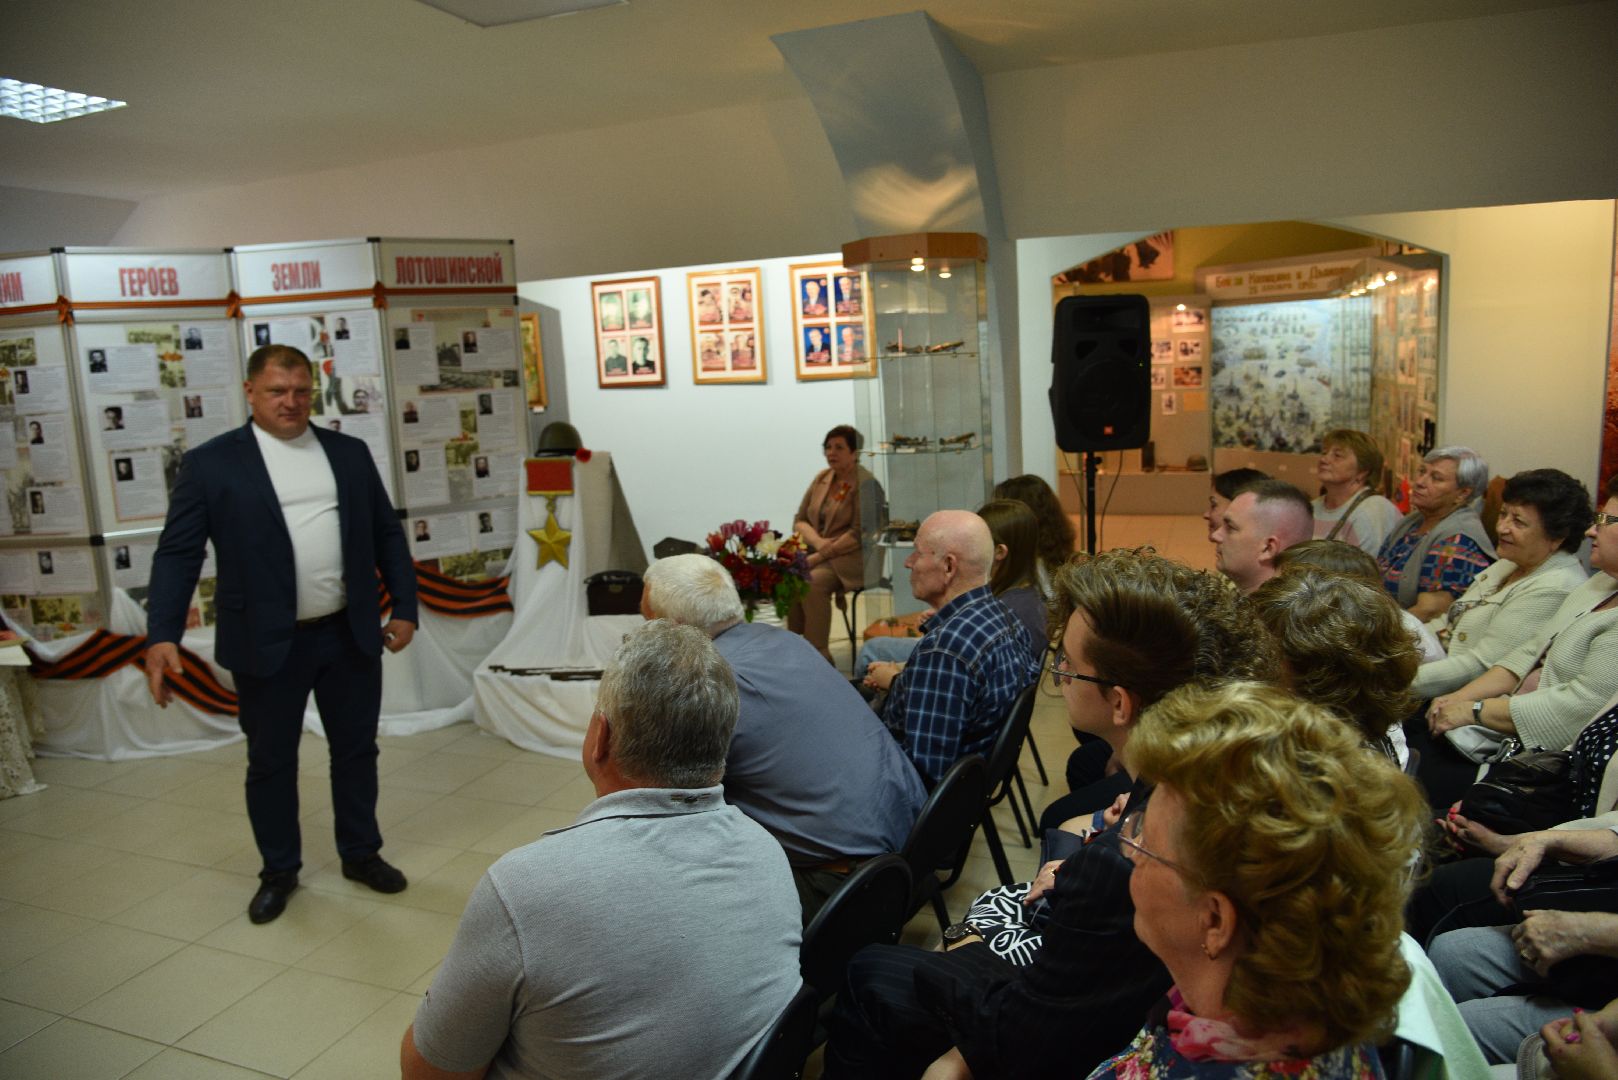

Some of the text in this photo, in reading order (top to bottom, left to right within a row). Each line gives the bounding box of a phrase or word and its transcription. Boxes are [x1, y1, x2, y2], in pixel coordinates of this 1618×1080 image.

[0, 252, 504, 303] ИМ ГЕРОЕВ ЗЕМЛИ ЛОТОШИНСКОЙ
